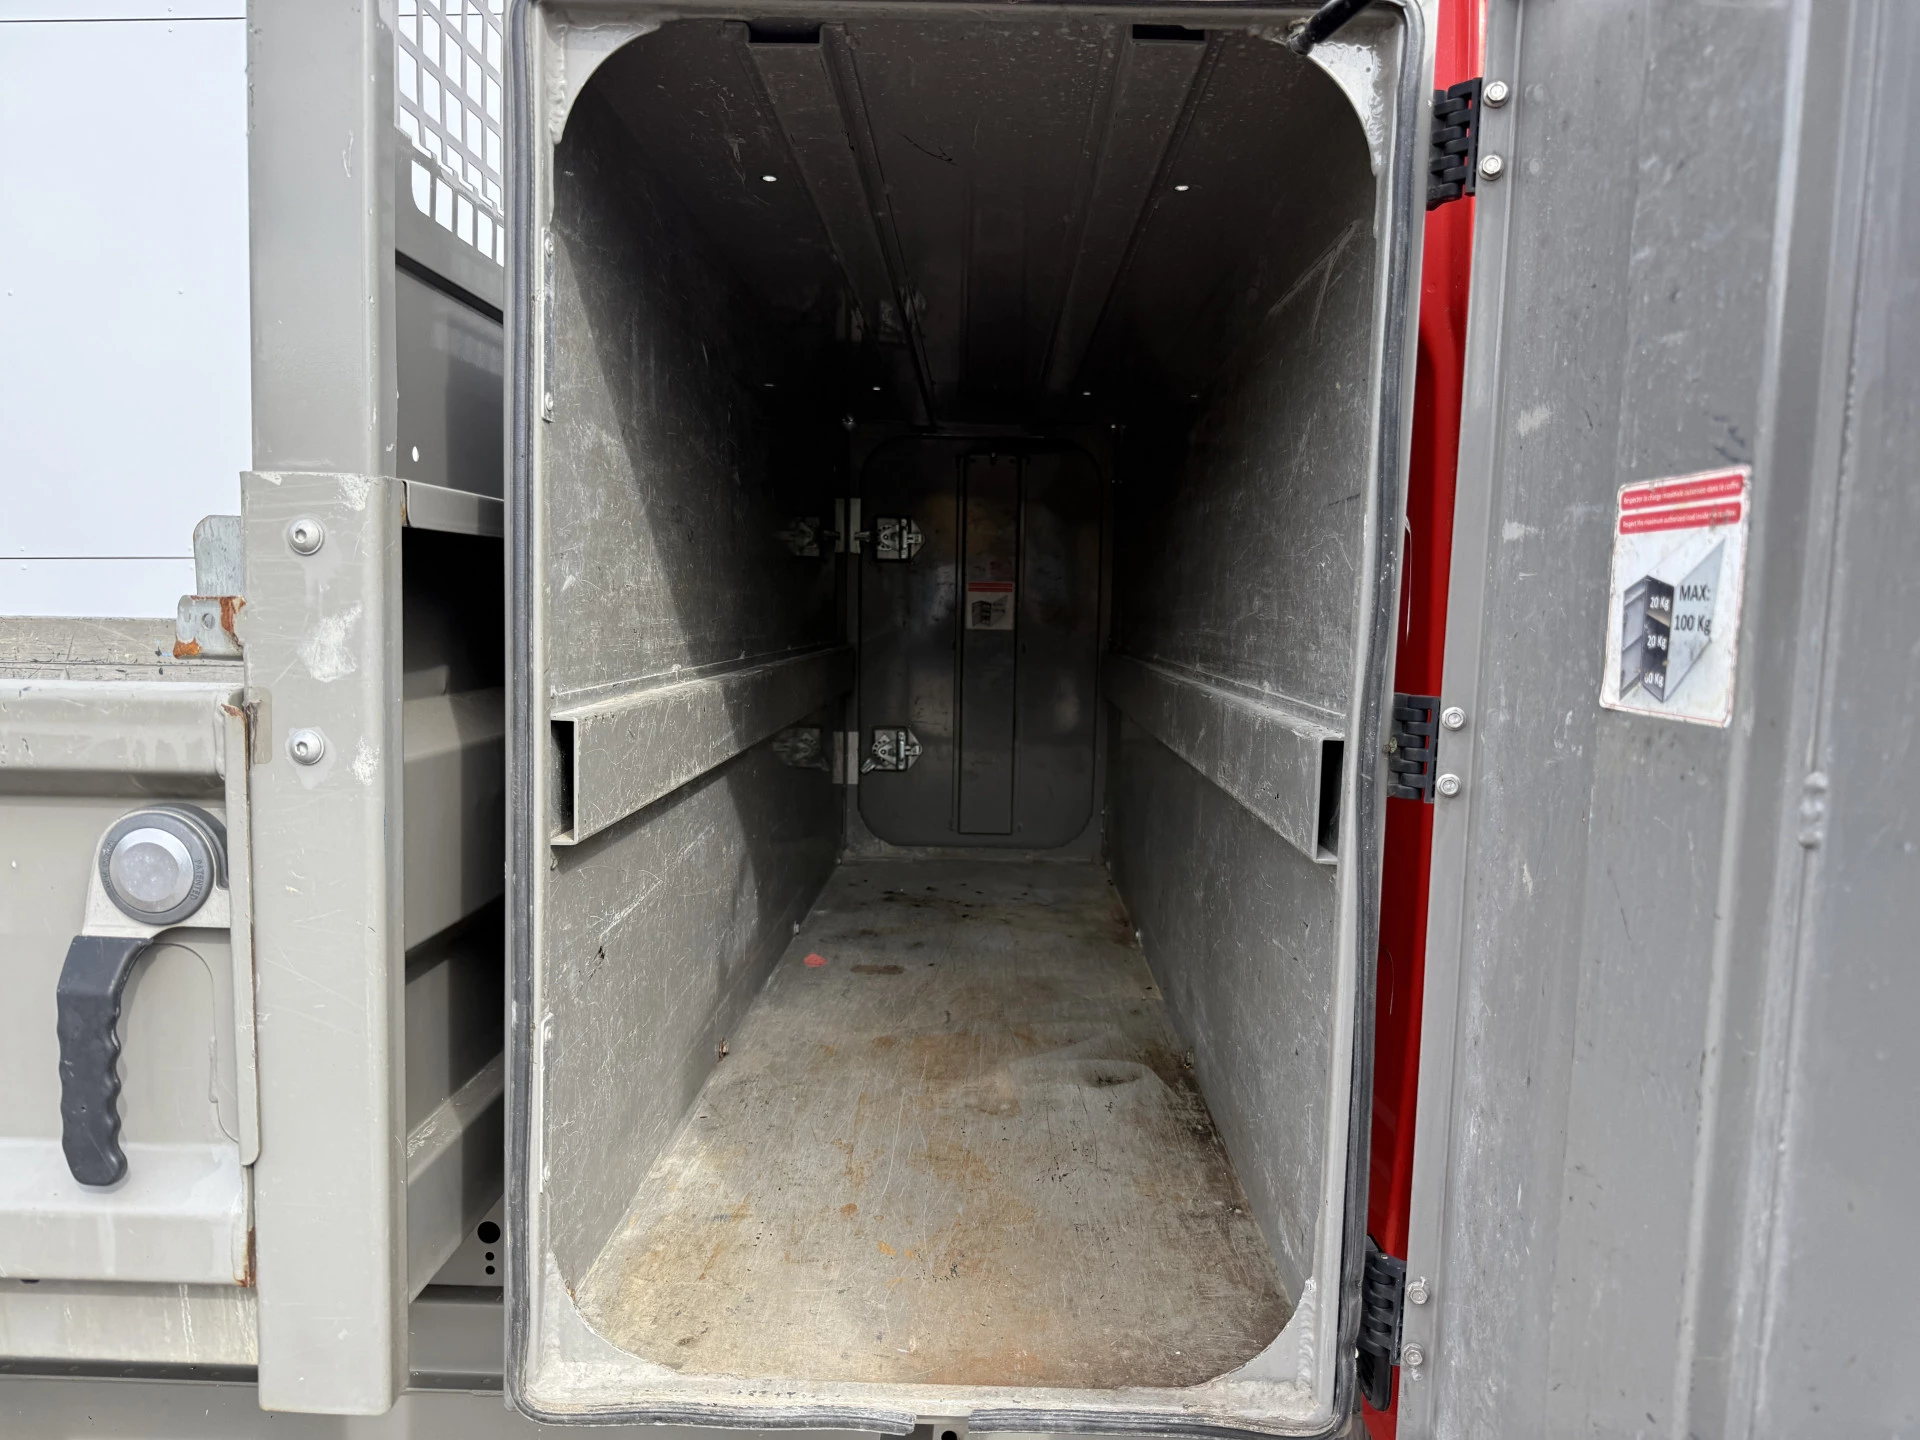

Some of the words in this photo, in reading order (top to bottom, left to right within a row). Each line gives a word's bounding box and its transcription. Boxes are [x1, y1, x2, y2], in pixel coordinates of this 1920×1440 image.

[1624, 496, 1642, 505] Respecter
[1622, 520, 1636, 529] Respect
[1679, 584, 1710, 601] MAX:
[1650, 597, 1659, 609] 20
[1660, 596, 1669, 611] Kg
[1674, 614, 1695, 631] 100
[1697, 615, 1712, 636] Kg
[1647, 635, 1656, 648] 20
[1657, 635, 1666, 650] Kg
[1654, 673, 1664, 687] Kg
[190, 859, 205, 900] PATENTED
